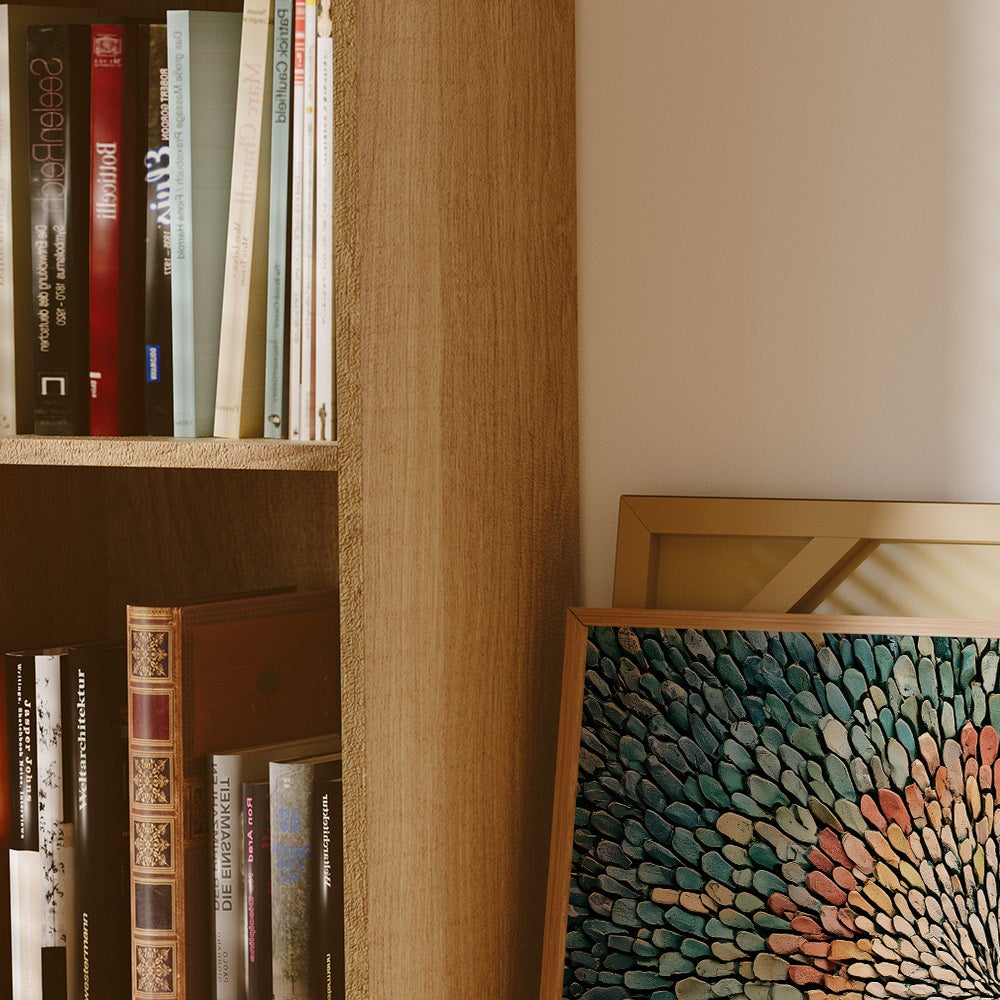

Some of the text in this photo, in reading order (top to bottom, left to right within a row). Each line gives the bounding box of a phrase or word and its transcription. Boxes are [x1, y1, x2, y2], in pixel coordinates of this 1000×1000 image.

[23, 700, 33, 803] Jasper Johns
[77, 669, 88, 811] Weltarchitektur
